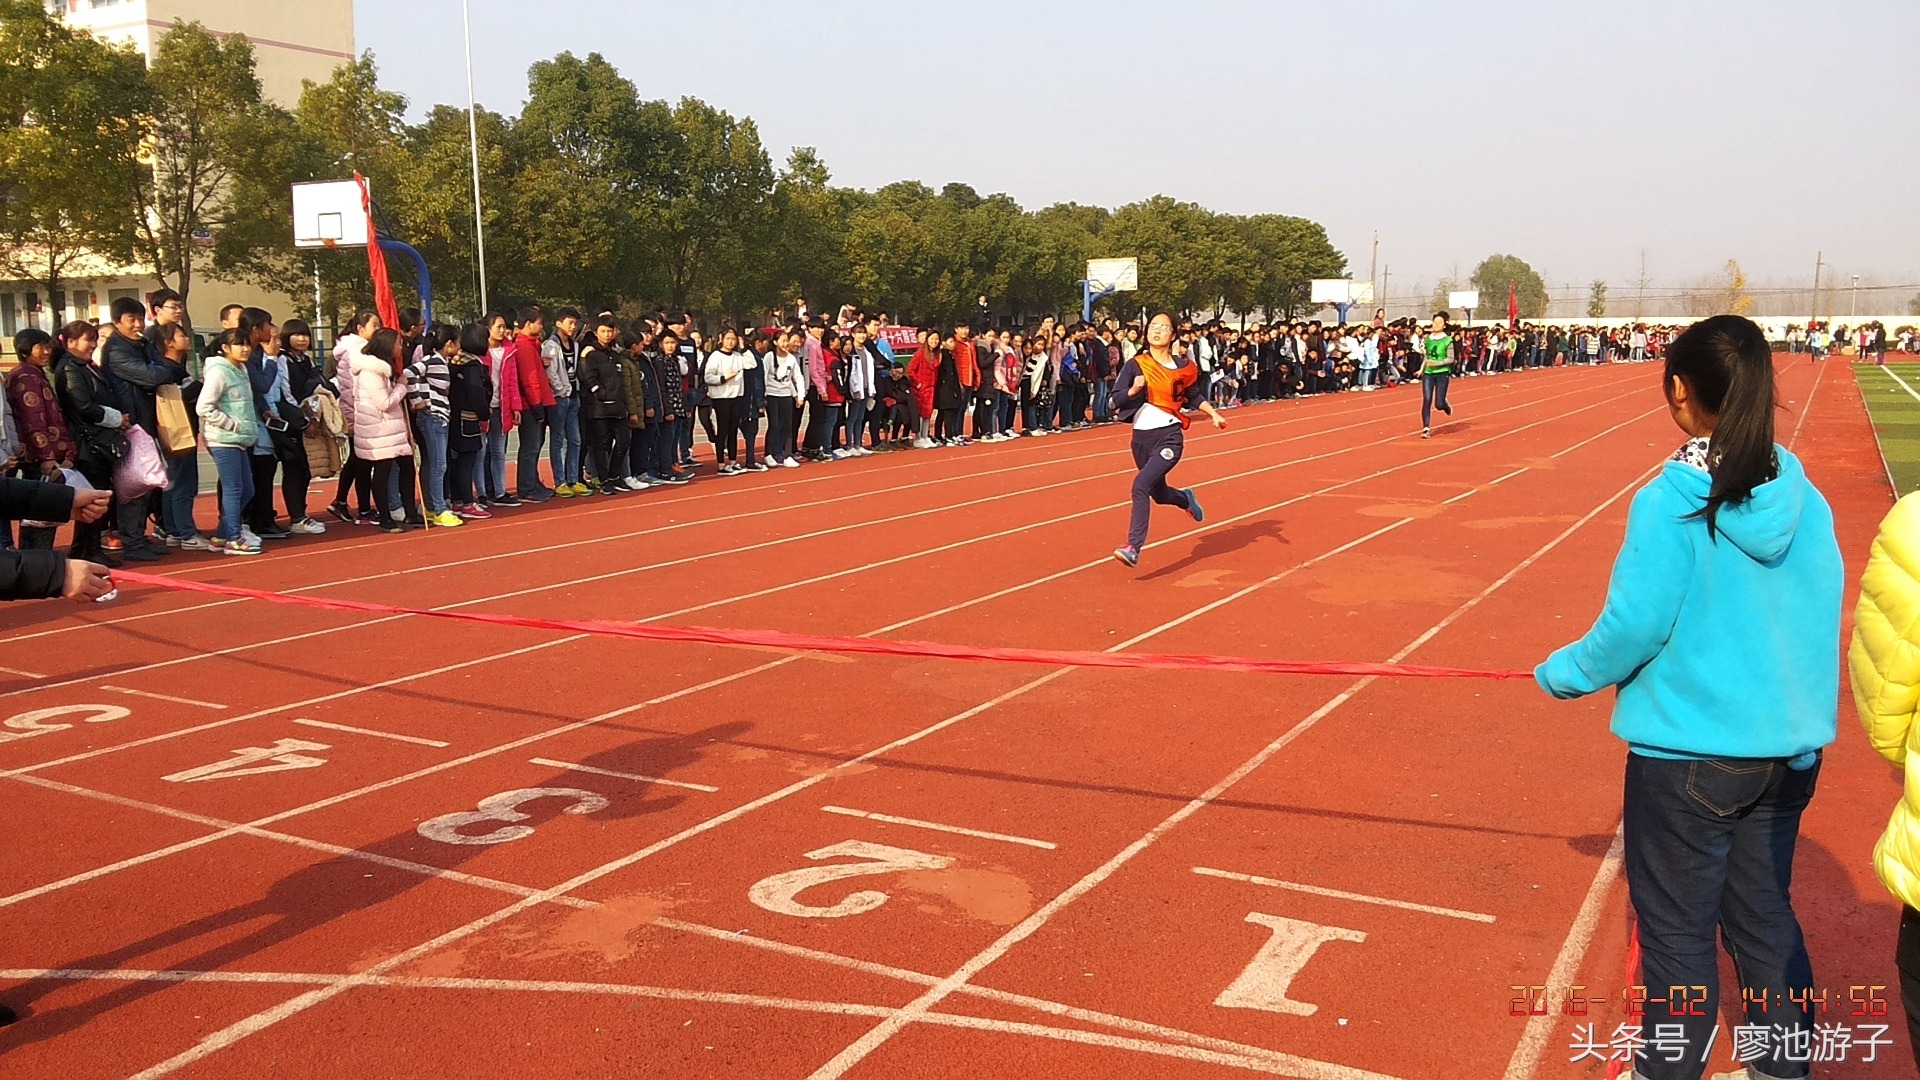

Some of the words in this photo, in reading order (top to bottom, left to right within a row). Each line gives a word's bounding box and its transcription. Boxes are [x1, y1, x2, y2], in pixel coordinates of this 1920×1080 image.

[0, 703, 132, 743] 5
[161, 738, 331, 782] 4
[417, 788, 610, 846] 3
[748, 839, 956, 918] 2
[1212, 911, 1368, 1017] 1
